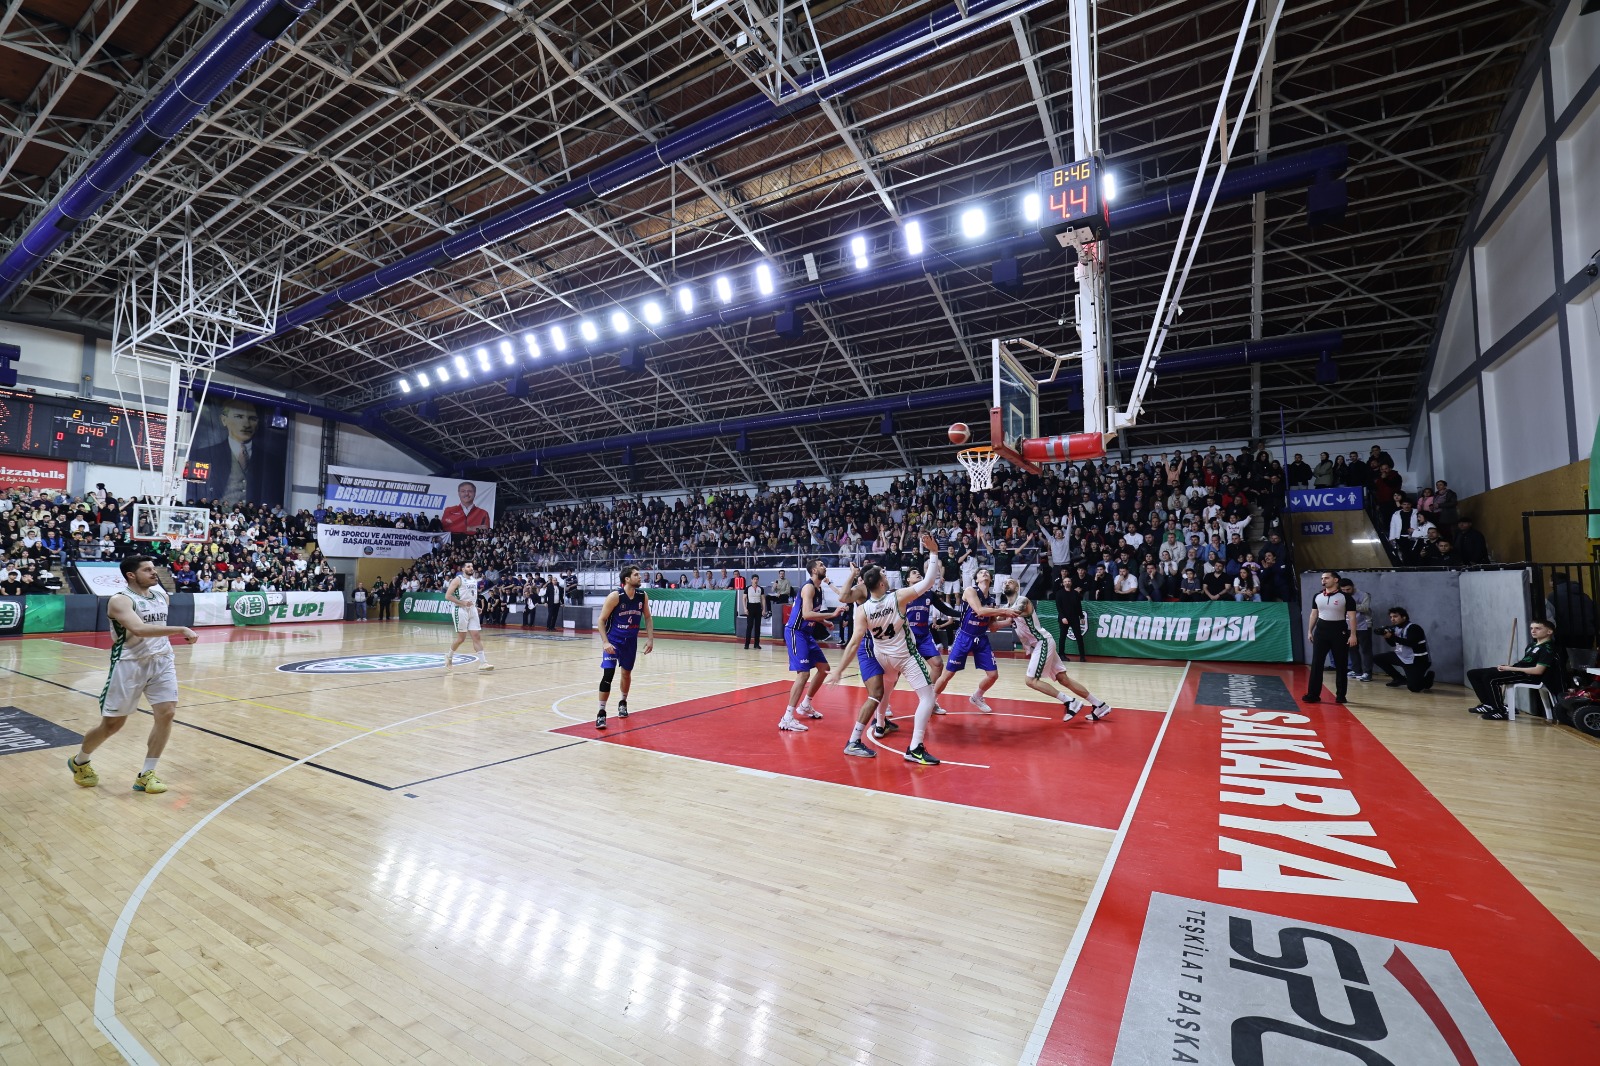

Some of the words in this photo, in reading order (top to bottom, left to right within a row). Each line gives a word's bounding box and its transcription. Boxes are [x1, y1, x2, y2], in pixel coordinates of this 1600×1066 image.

[1054, 162, 1090, 187] 8:46
[1049, 185, 1088, 219] 4.4
[72, 409, 82, 419] 2
[110, 415, 119, 425] 2
[56, 432, 64, 441] 0
[77, 425, 104, 437] 8:46
[339, 476, 354, 486] TÜM
[353, 478, 378, 488] SPORCU
[377, 481, 386, 489] VE
[385, 481, 428, 493] ANTRENÖRLERE
[334, 486, 396, 504] BAŞARILAR
[399, 493, 444, 508] DİLERİM
[1303, 493, 1334, 507] WC
[324, 528, 340, 537] TÜM
[339, 530, 371, 538] SPORCU
[381, 532, 430, 543] ANTRENÖRLERE
[1310, 524, 1324, 533] WC
[342, 537, 384, 546] BAŞARILAR
[384, 539, 411, 547] DİLERİM
[248, 596, 262, 615] SBB
[292, 601, 325, 618] UP!
[648, 599, 692, 619] SAKARYA
[691, 601, 722, 620] BBSK
[627, 615, 633, 625] 4
[915, 611, 921, 621] 8
[871, 622, 896, 640] 24
[1096, 614, 1192, 641] SAKARYA
[1195, 615, 1259, 642] BBSK
[1218, 708, 1419, 904] SAKARYA
[1178, 909, 1207, 984] TEŞKİLAT
